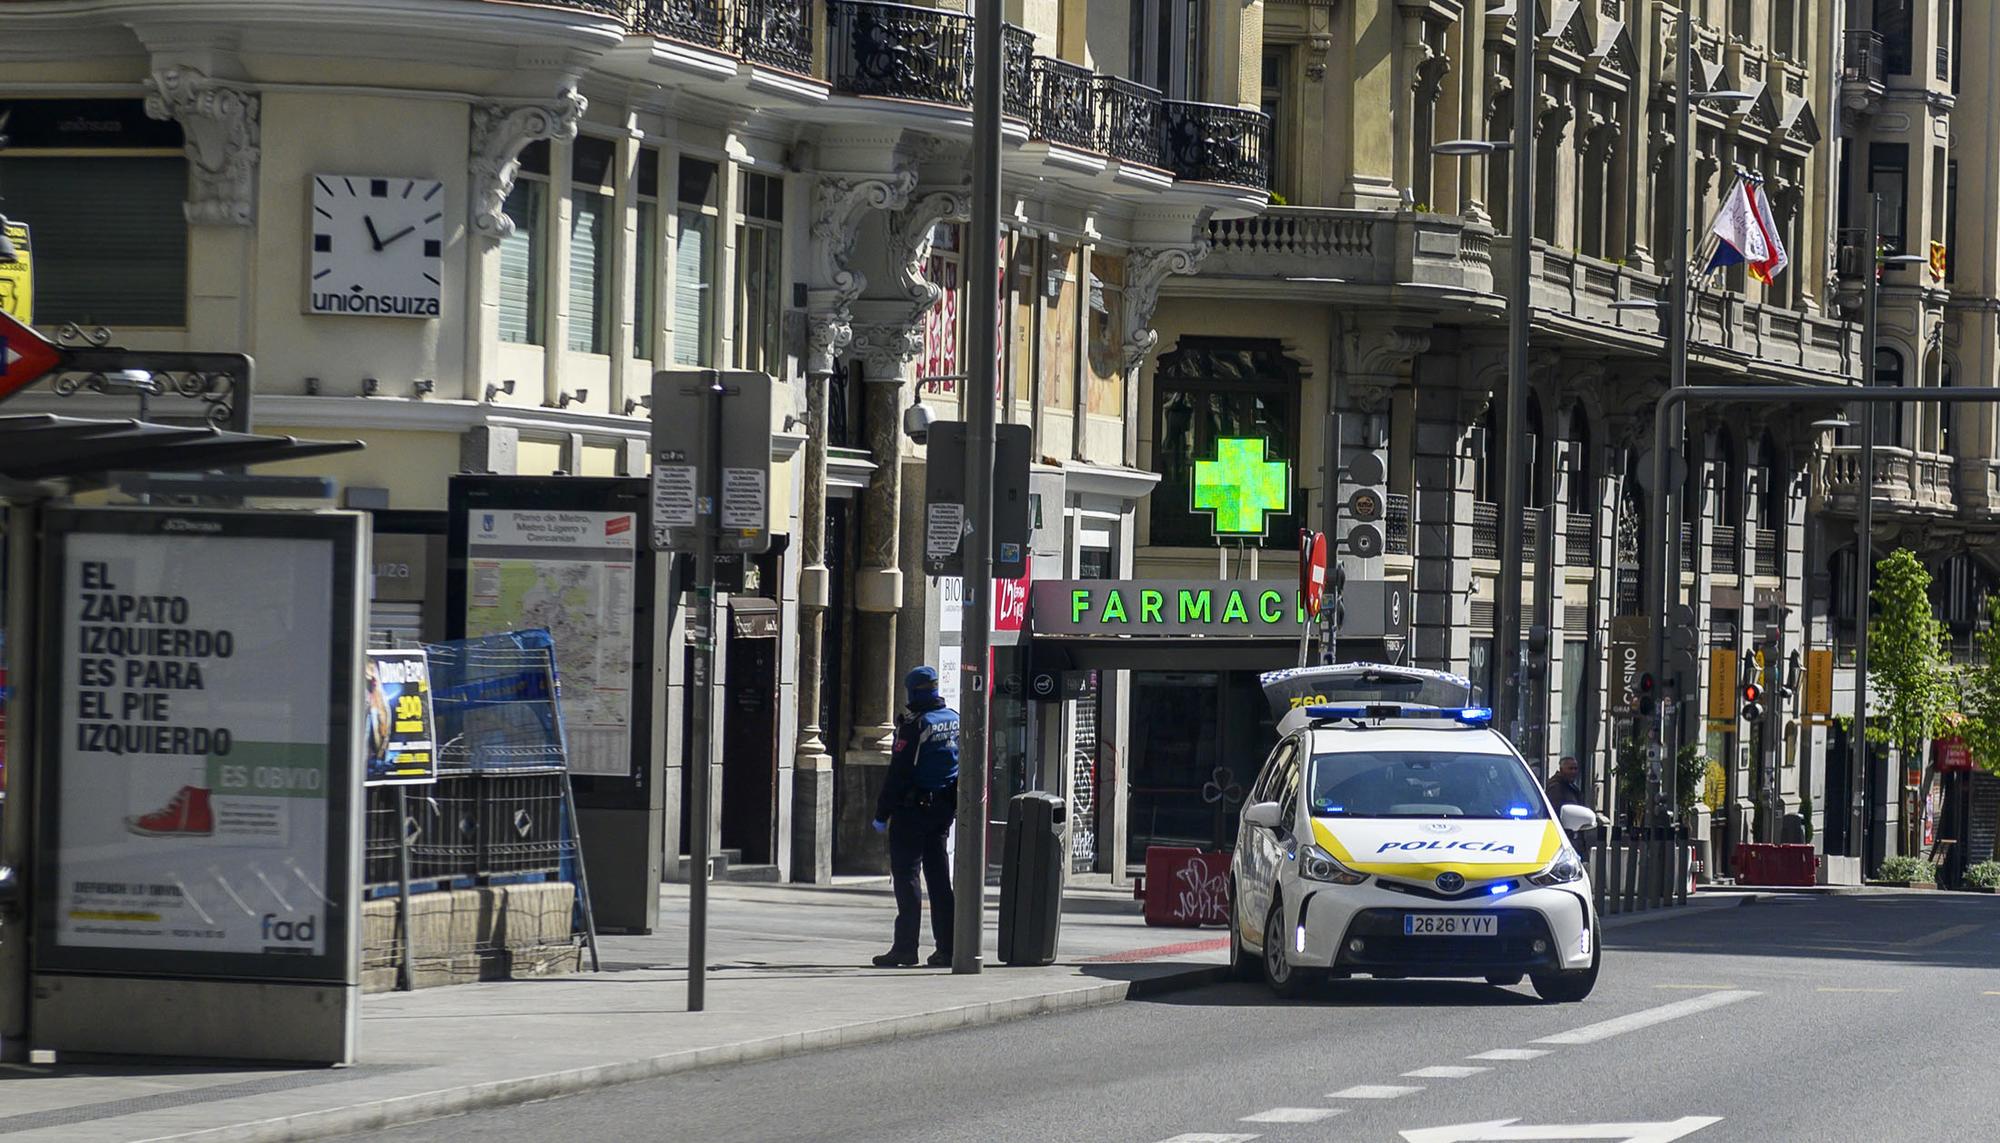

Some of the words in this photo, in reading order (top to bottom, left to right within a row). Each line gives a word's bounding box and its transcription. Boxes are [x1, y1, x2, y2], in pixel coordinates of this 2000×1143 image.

[80, 561, 115, 590] EL
[79, 594, 190, 625] ZAPATO
[1071, 590, 1322, 623] FARMACI
[79, 626, 234, 659] IZQUIERDO
[78, 658, 116, 687] ES
[125, 659, 205, 690] PARA
[78, 691, 113, 720] EL
[122, 692, 169, 721] PIE
[77, 723, 232, 756] IZQUIERDO
[219, 764, 248, 788] ES
[253, 766, 320, 790] OBVIO
[1376, 840, 1514, 854] POLICÍA
[262, 913, 315, 942] fad
[1415, 918, 1455, 933] 2626
[1461, 917, 1492, 931] YVY
